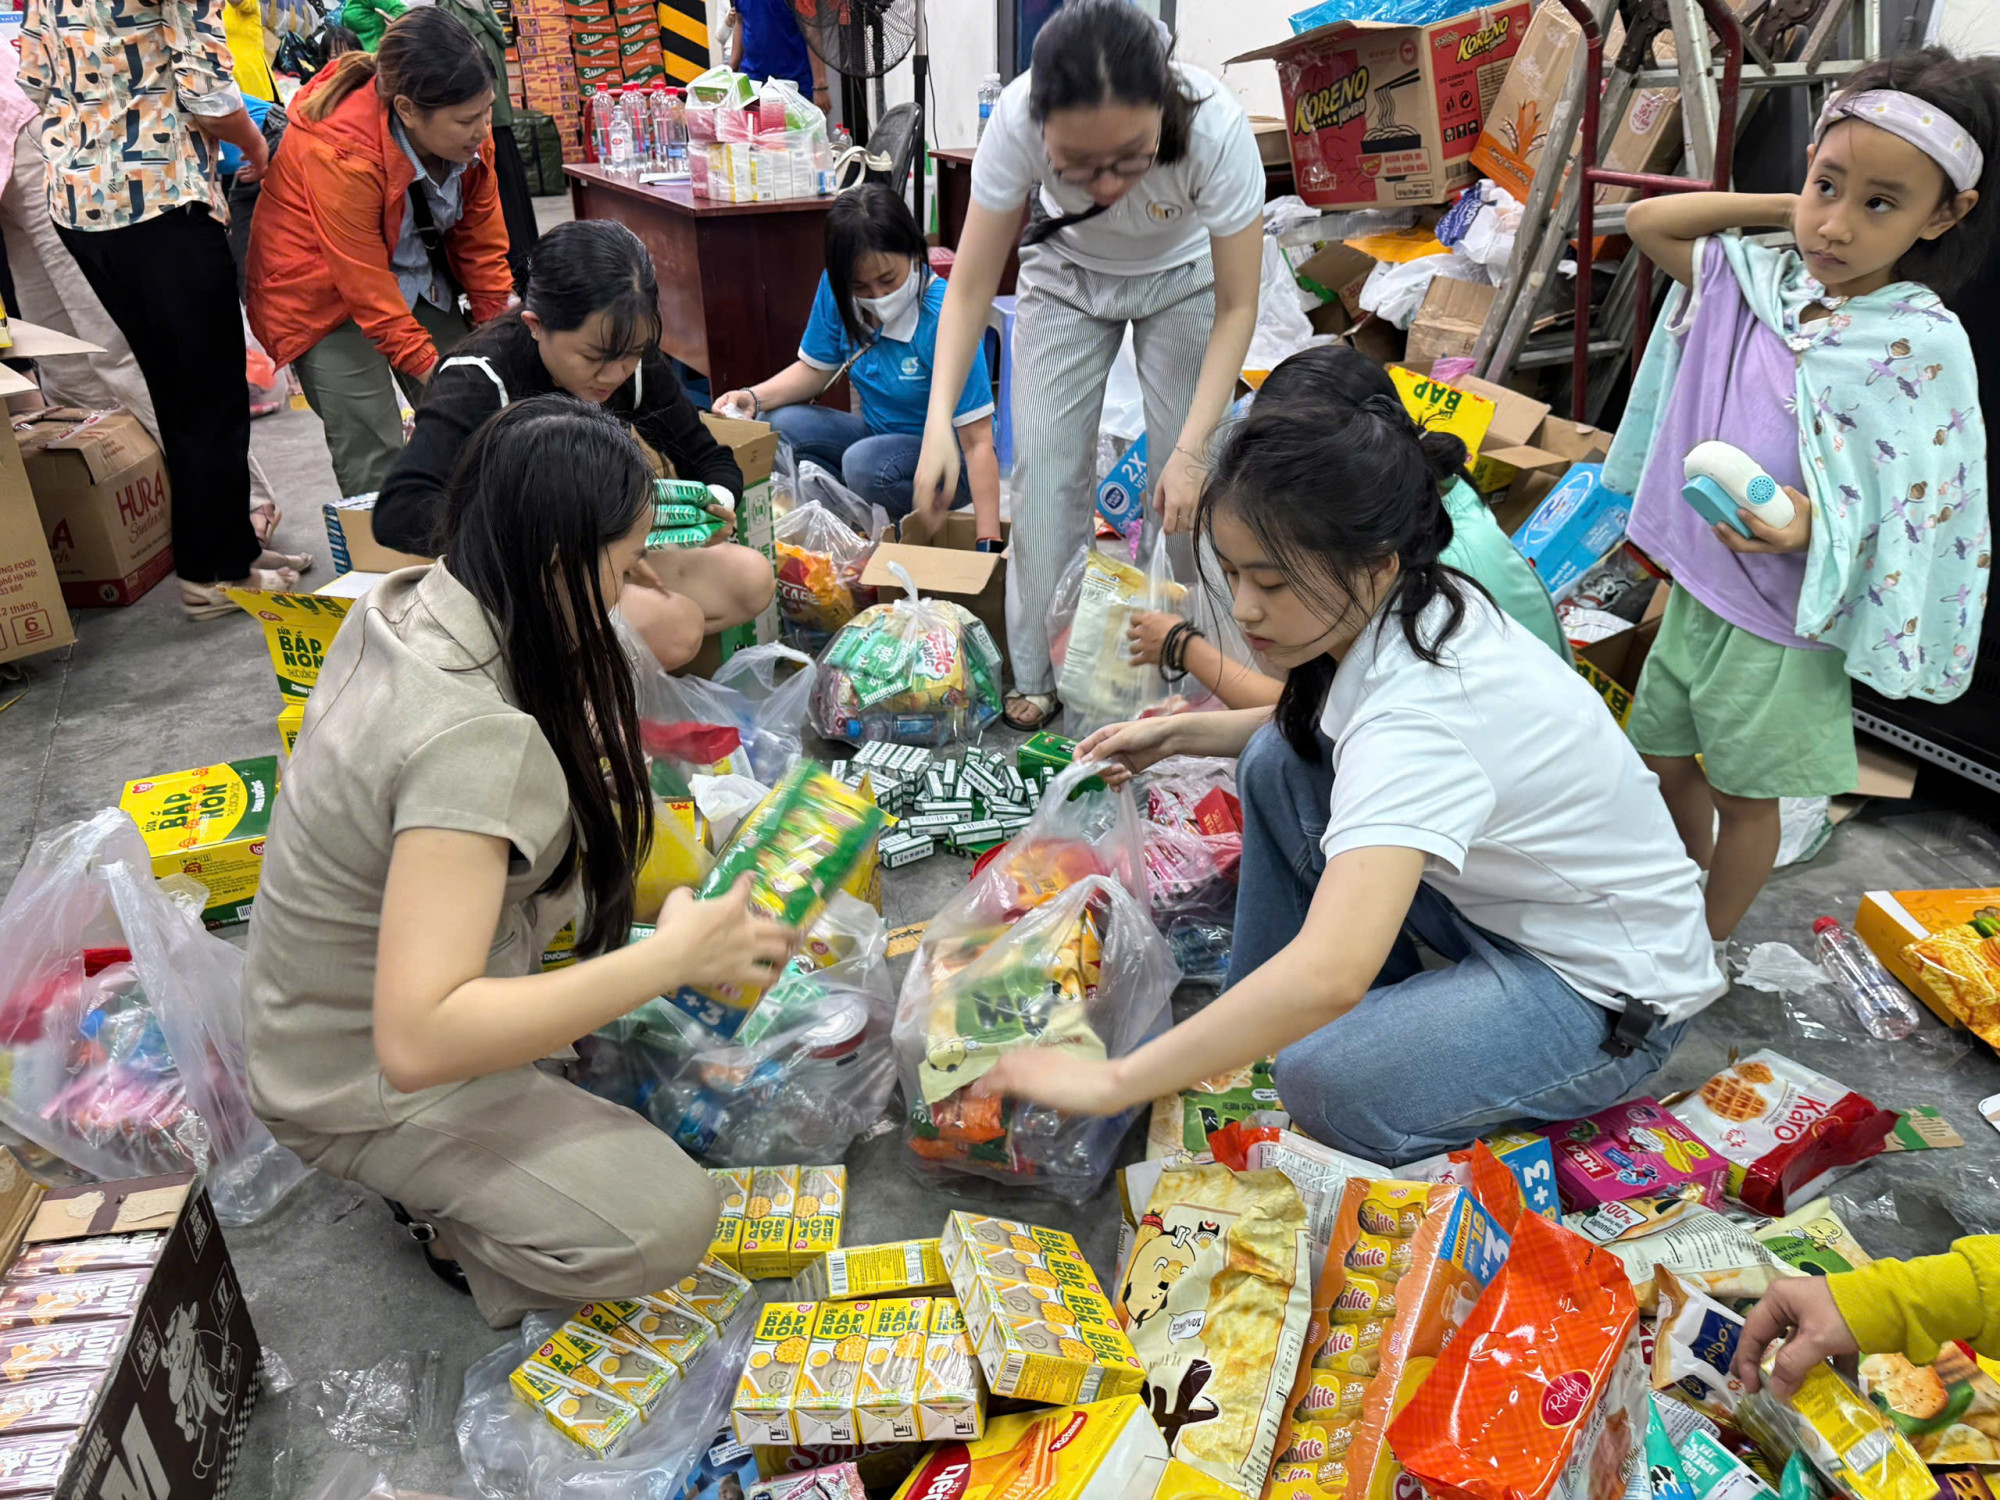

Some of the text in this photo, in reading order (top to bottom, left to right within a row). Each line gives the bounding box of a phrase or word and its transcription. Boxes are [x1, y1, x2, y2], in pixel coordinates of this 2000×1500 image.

[1456, 15, 1510, 63] KORENO
[1294, 65, 1369, 135] KORENO
[116, 471, 166, 527] HURA
[14, 559, 37, 571] FOOD
[9, 601, 39, 614] tháng
[24, 617, 39, 632] 6
[278, 631, 323, 654] BẮP
[284, 653, 325, 669] NON
[1774, 1095, 1827, 1142] Karo
[1566, 1144, 1602, 1174] HURA
[1359, 1209, 1396, 1234] Solite
[1601, 1202, 1633, 1225] 100%
[1472, 1211, 1486, 1242] 18
[764, 1311, 807, 1327] BẮP
[823, 1309, 865, 1326] BẮP
[760, 1325, 804, 1337] NON
[819, 1324, 862, 1335] NON
[1303, 1385, 1336, 1410] olite
[1546, 1377, 1590, 1416] Richy
